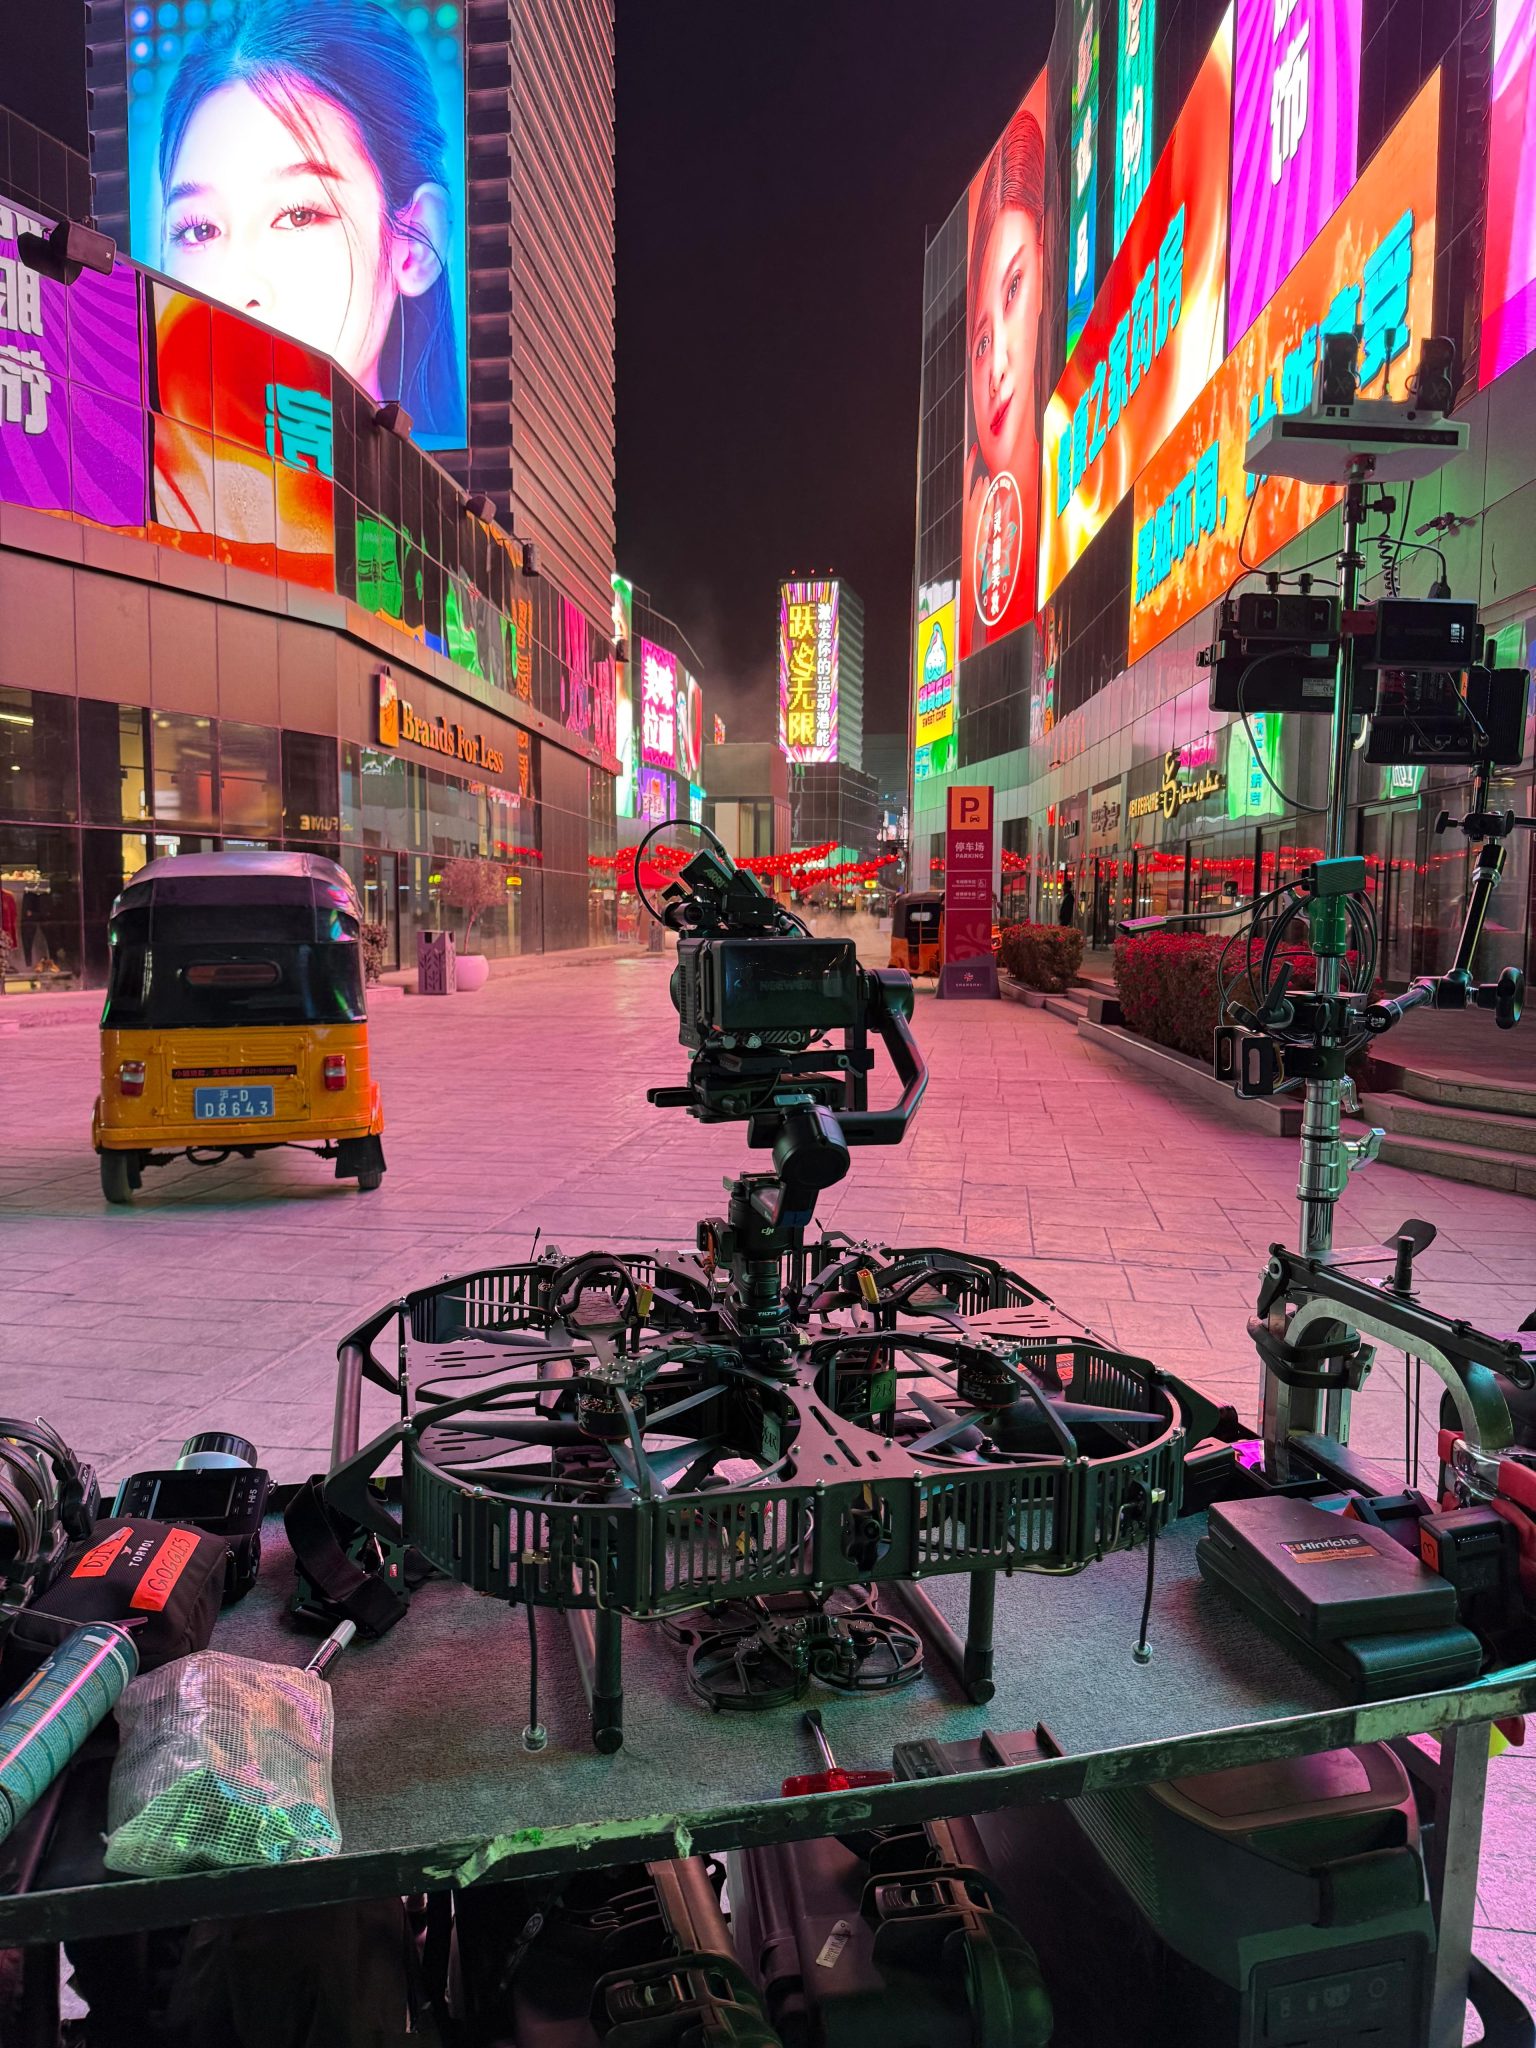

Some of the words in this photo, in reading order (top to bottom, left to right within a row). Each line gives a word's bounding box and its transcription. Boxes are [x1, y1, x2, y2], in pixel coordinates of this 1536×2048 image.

[1270, 0, 1311, 187] 饰
[1057, 202, 1185, 518] 健康之家药房
[816, 603, 831, 747] 激发你的运动潜能
[401, 699, 455, 756] Brands
[456, 724, 479, 763] For
[480, 735, 504, 774] Less
[960, 796, 980, 823] P
[955, 841, 985, 852] 停车场
[703, 868, 726, 887] ARRI
[205, 1101, 268, 1117] D8643
[129, 1540, 154, 1567] TORVOL
[1300, 1537, 1360, 1551] Hinrichs
[148, 1537, 191, 1592] GOGGLES
